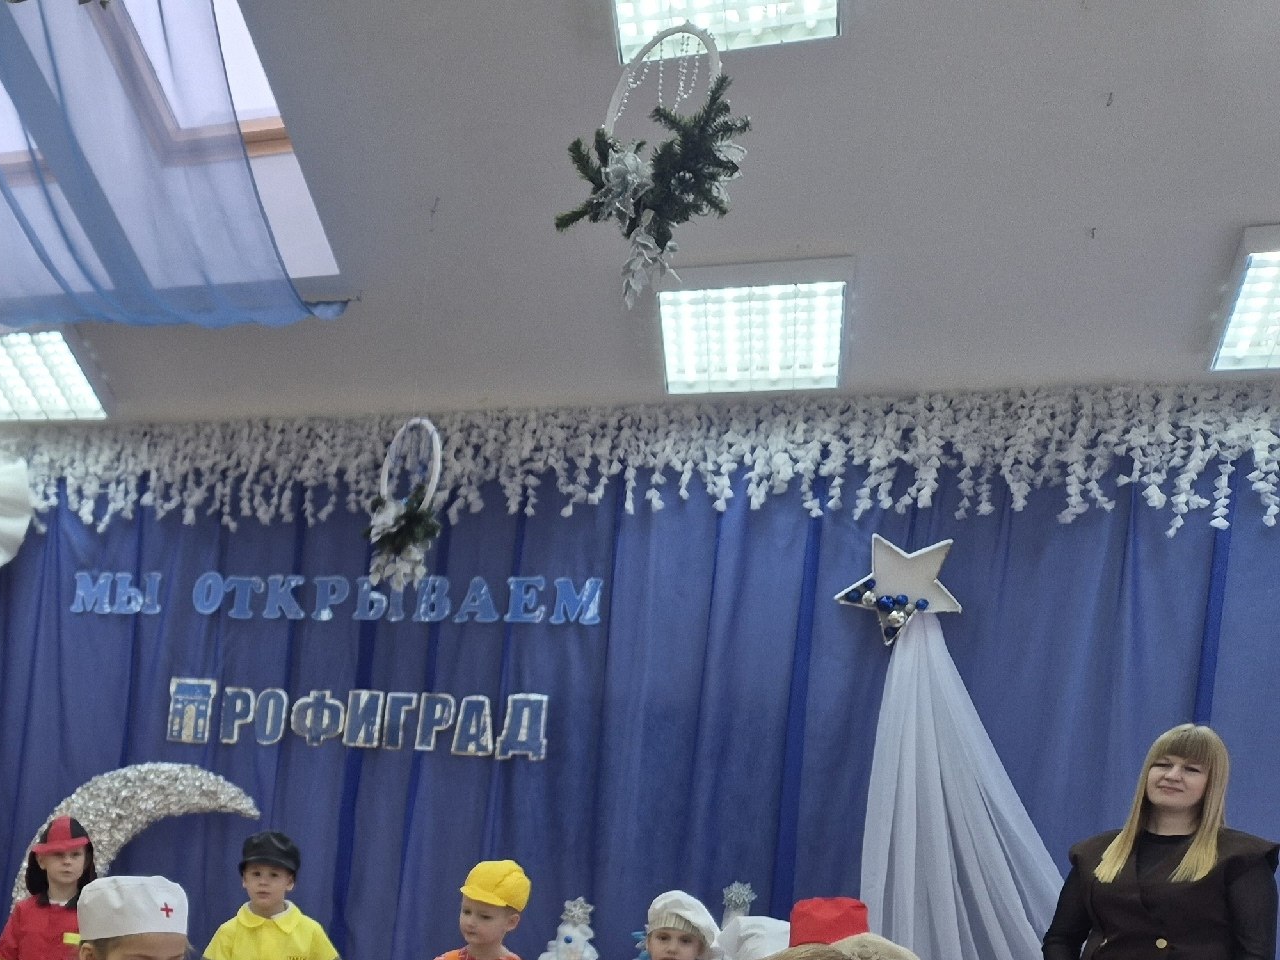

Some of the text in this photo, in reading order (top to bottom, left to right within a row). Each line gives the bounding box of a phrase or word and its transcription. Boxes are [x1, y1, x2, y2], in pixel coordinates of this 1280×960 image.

[69, 571, 604, 625] МЫ ОТКРЫВАЕМ
[166, 677, 549, 761] ПРОФИГРАД
